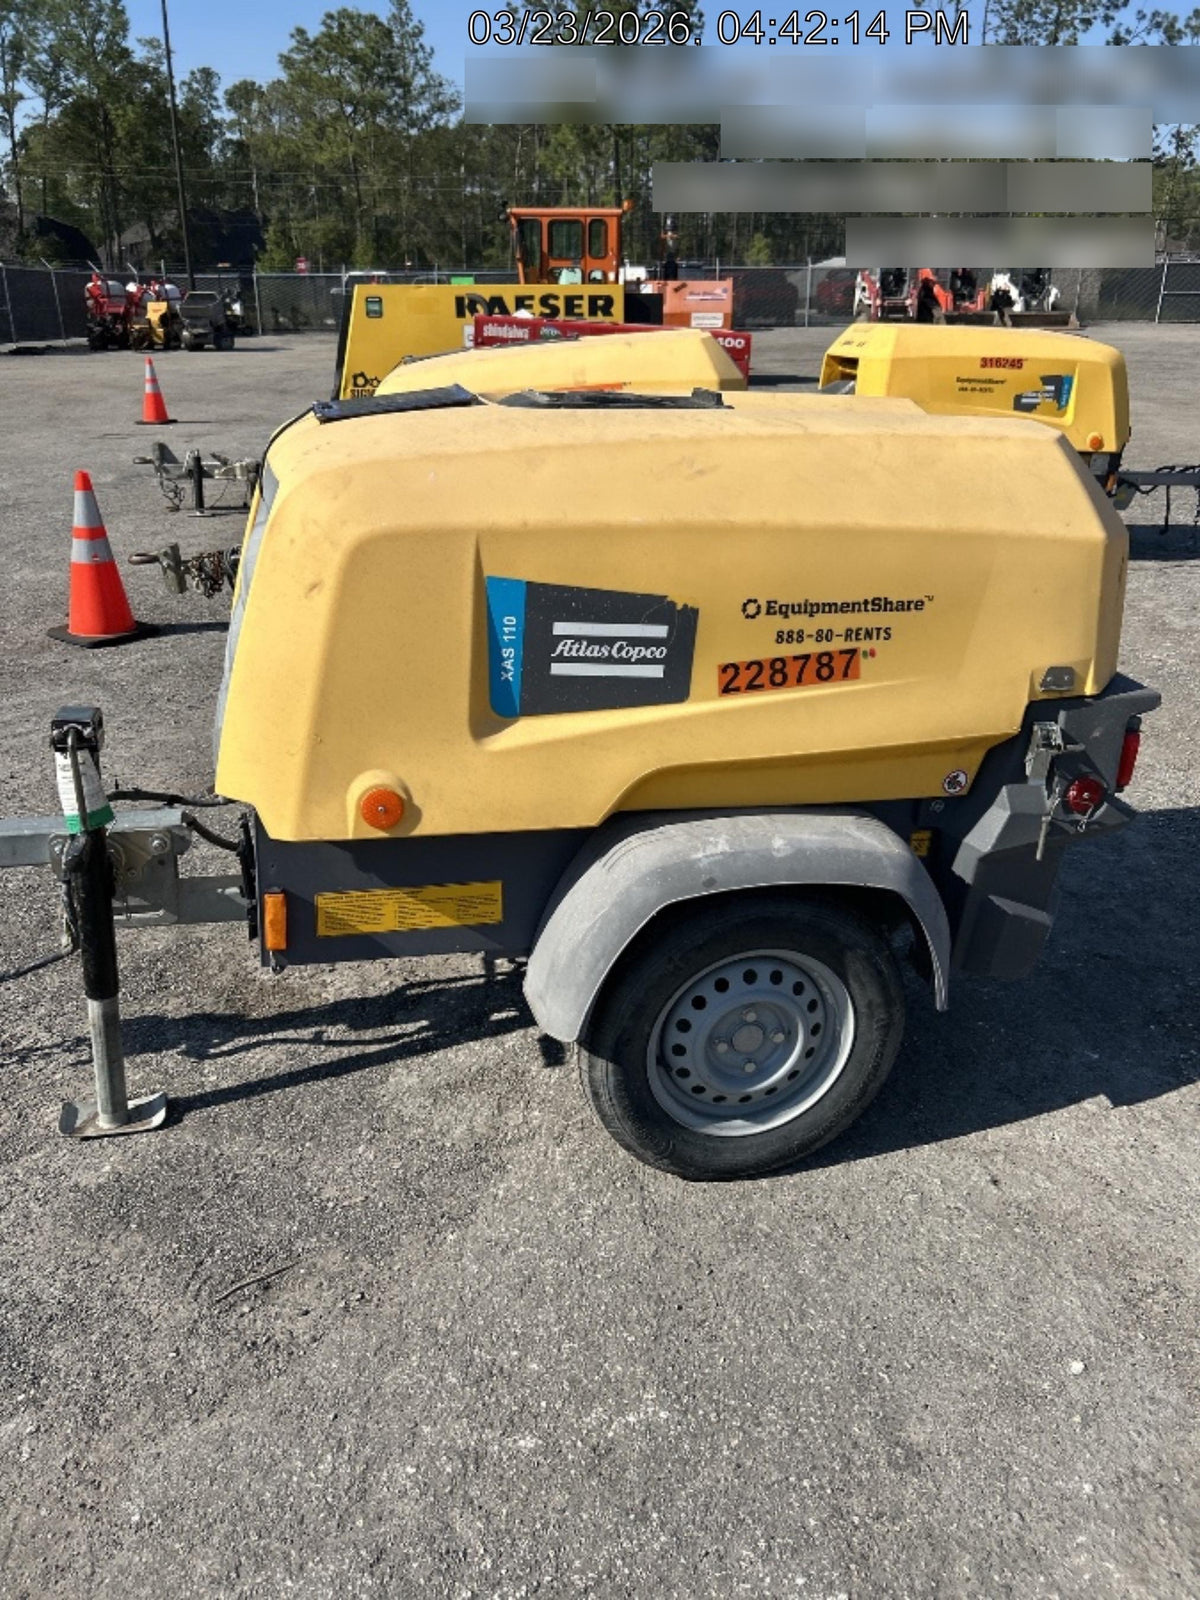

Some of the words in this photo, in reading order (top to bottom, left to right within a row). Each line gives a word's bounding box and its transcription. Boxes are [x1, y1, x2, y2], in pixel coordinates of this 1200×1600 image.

[455, 293, 614, 319] KAESER
[980, 357, 1023, 369] 316245
[503, 615, 517, 642] 110
[775, 626, 892, 645] 888-80-RENTS
[551, 639, 610, 658] Atlas
[611, 641, 668, 663] Copco
[501, 647, 515, 682] XAS
[721, 648, 859, 695] 228787
